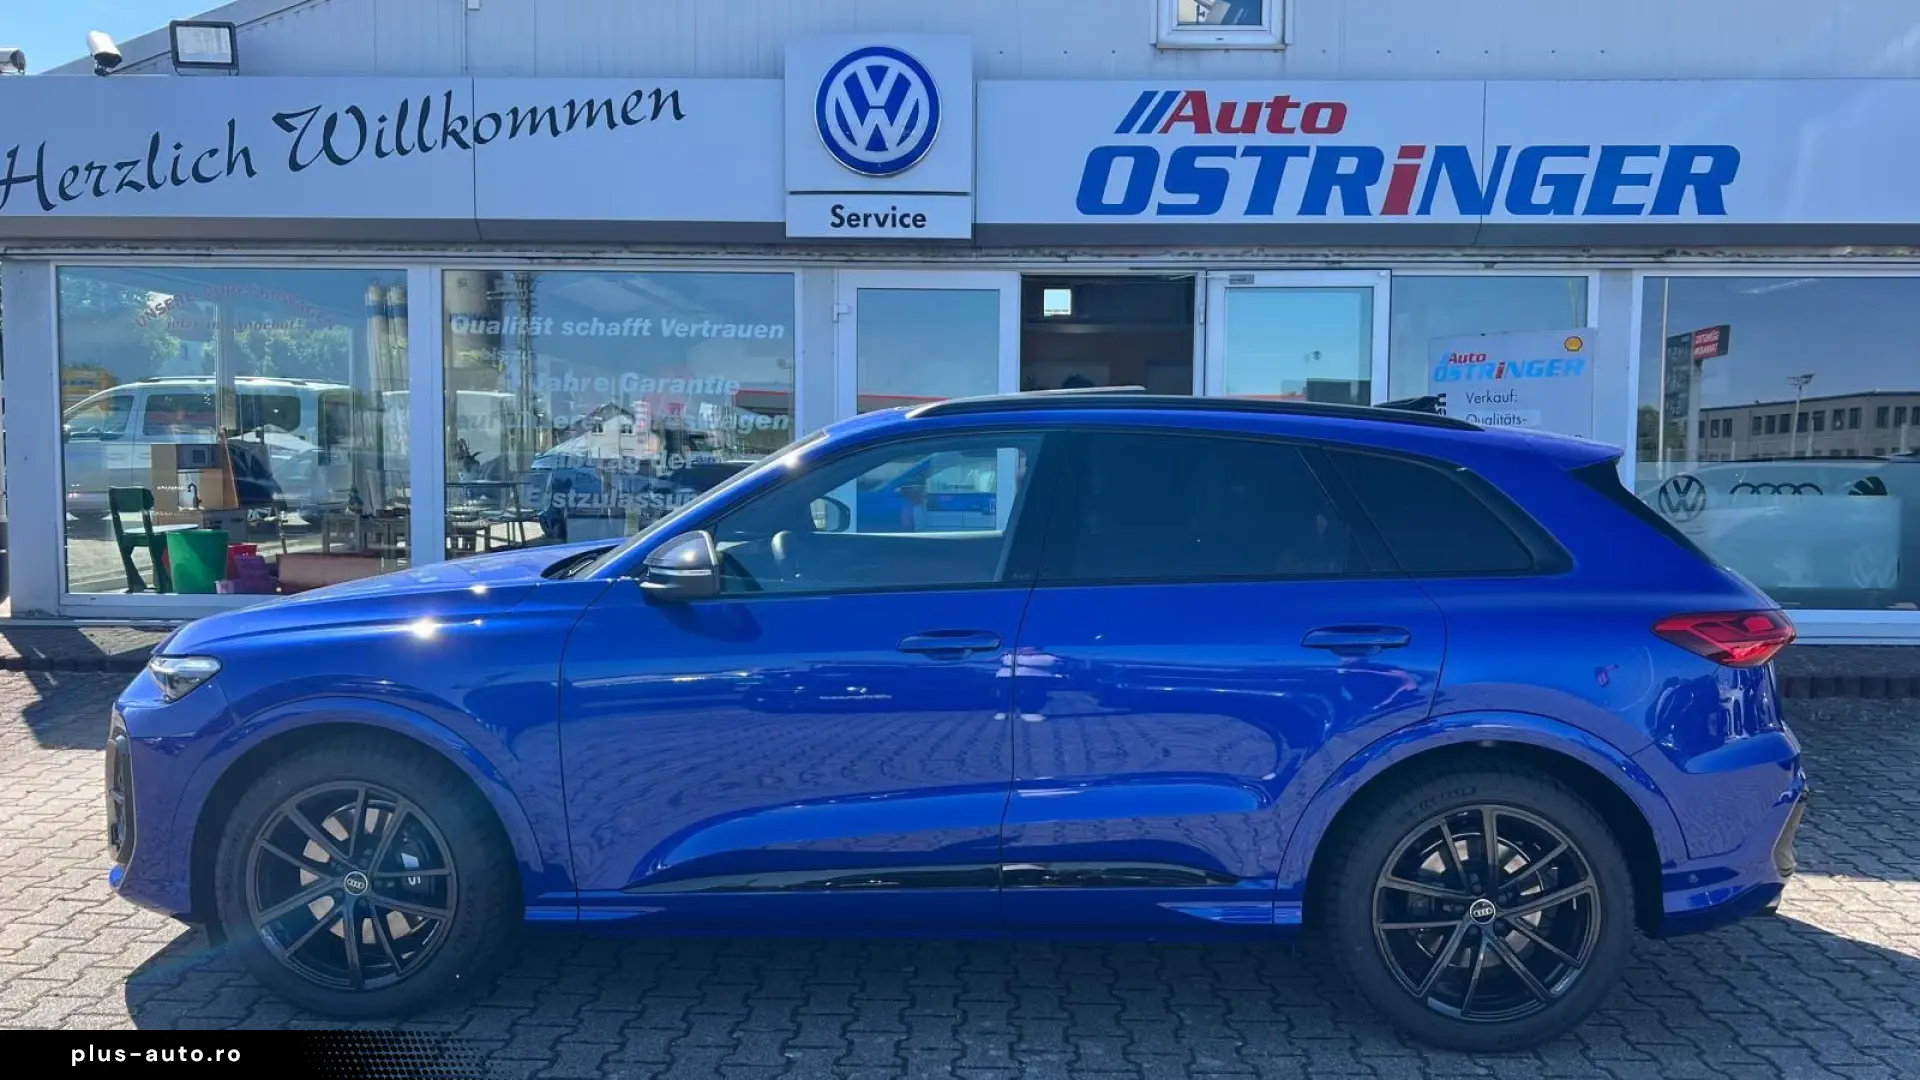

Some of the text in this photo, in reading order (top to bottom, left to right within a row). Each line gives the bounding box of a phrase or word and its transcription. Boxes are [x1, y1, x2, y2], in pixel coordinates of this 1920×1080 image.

[1159, 90, 1348, 134] Auto
[0, 88, 688, 212] Herzlich Willkommen
[830, 203, 927, 229] Service
[450, 314, 785, 339] Qualität schafft Vertrauen
[1448, 352, 1488, 365] Auto
[533, 371, 609, 393] Jahre
[619, 371, 741, 395] Garantie
[1466, 389, 1518, 405] Verkauf:
